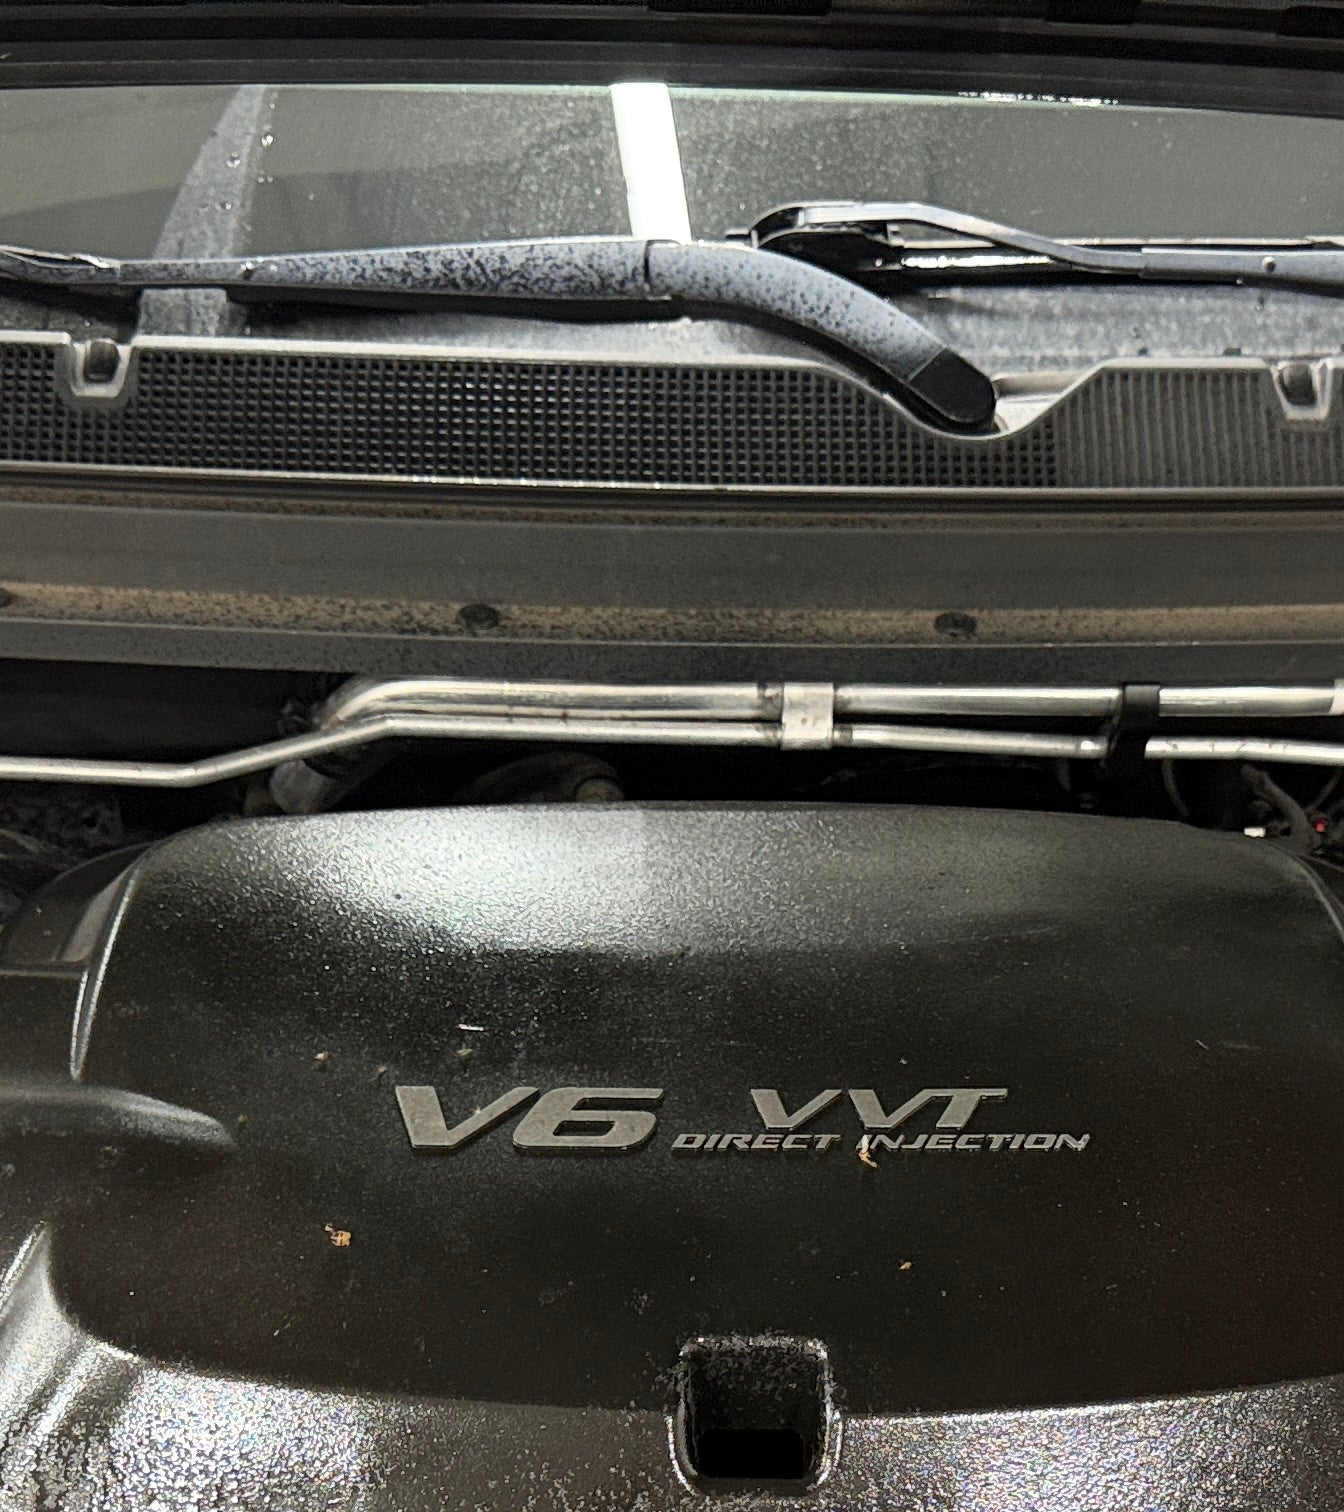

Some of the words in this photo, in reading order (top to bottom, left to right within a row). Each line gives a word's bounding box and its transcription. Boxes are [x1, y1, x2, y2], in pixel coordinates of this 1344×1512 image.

[395, 1084, 664, 1150] V6
[749, 1087, 1009, 1131] VVT
[671, 1133, 842, 1152] DIRECT
[857, 1133, 1092, 1152] INJECTION
